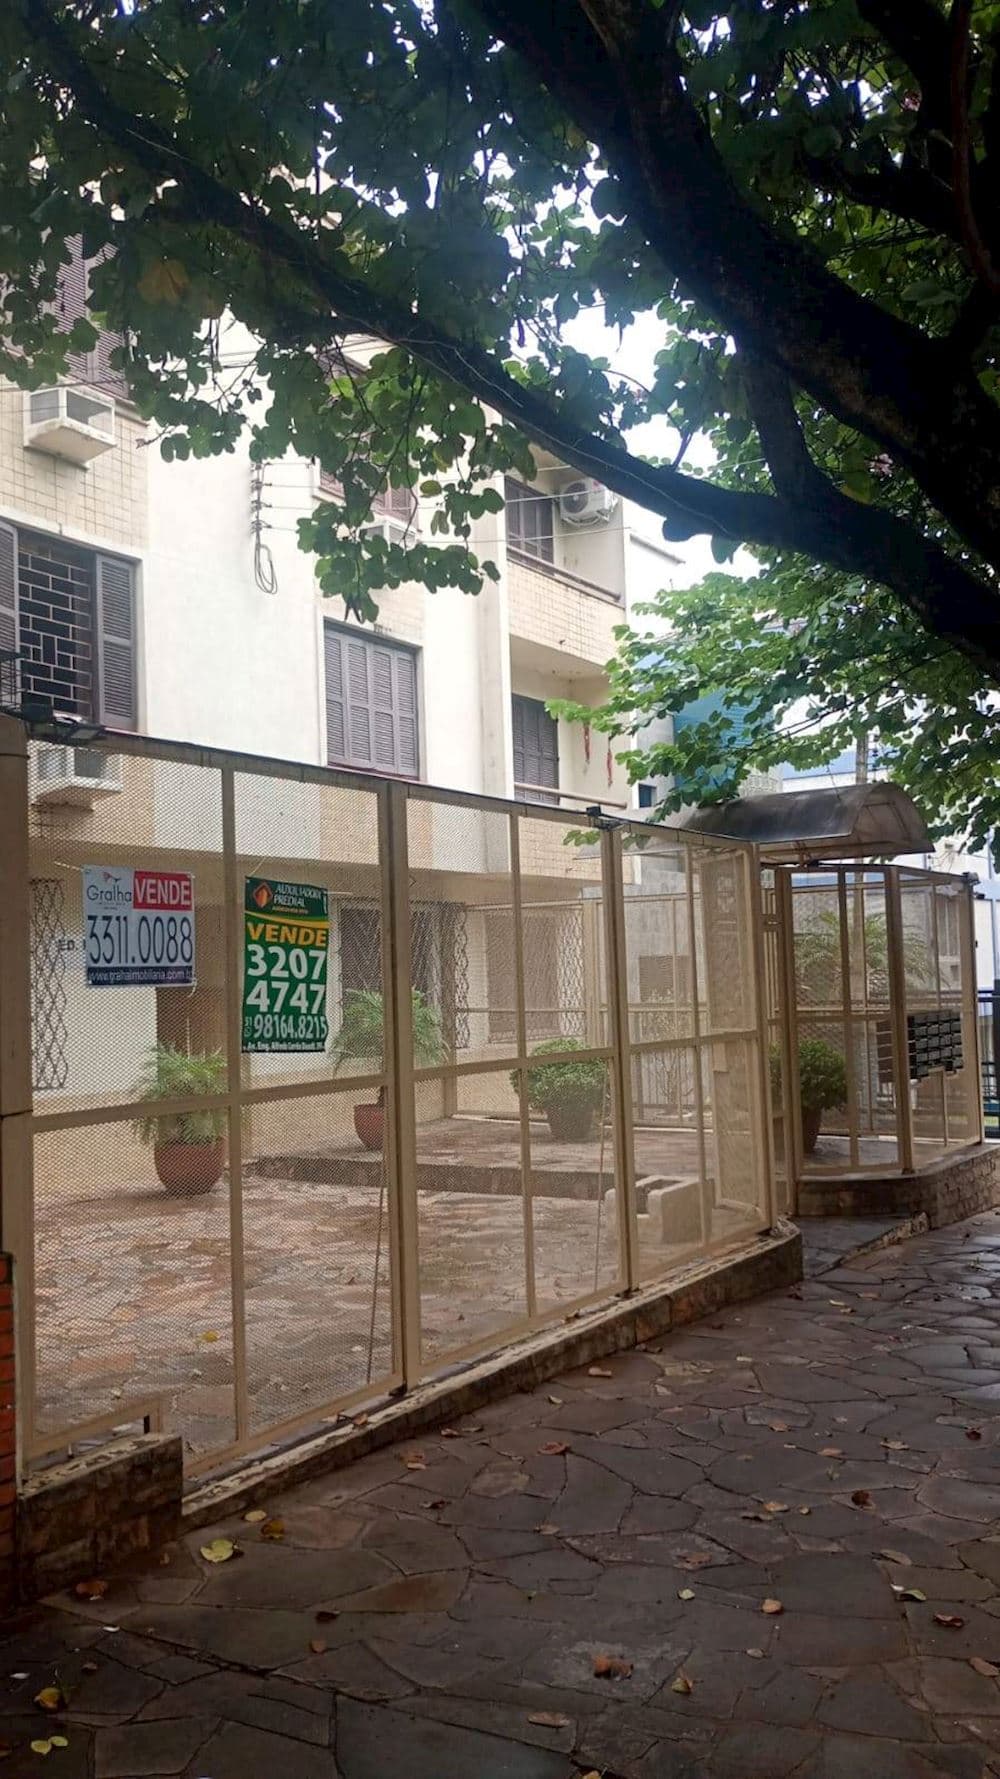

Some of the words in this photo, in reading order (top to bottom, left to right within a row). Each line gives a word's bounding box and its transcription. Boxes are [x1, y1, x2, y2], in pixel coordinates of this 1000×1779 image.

[86, 884, 132, 902] Gralha
[134, 878, 191, 906] VENDE
[87, 914, 193, 964] 3311.0088
[246, 922, 327, 947] VENDE
[247, 944, 327, 980] 3207
[246, 980, 326, 1015] 4747
[253, 1014, 328, 1039] 98164.8215
